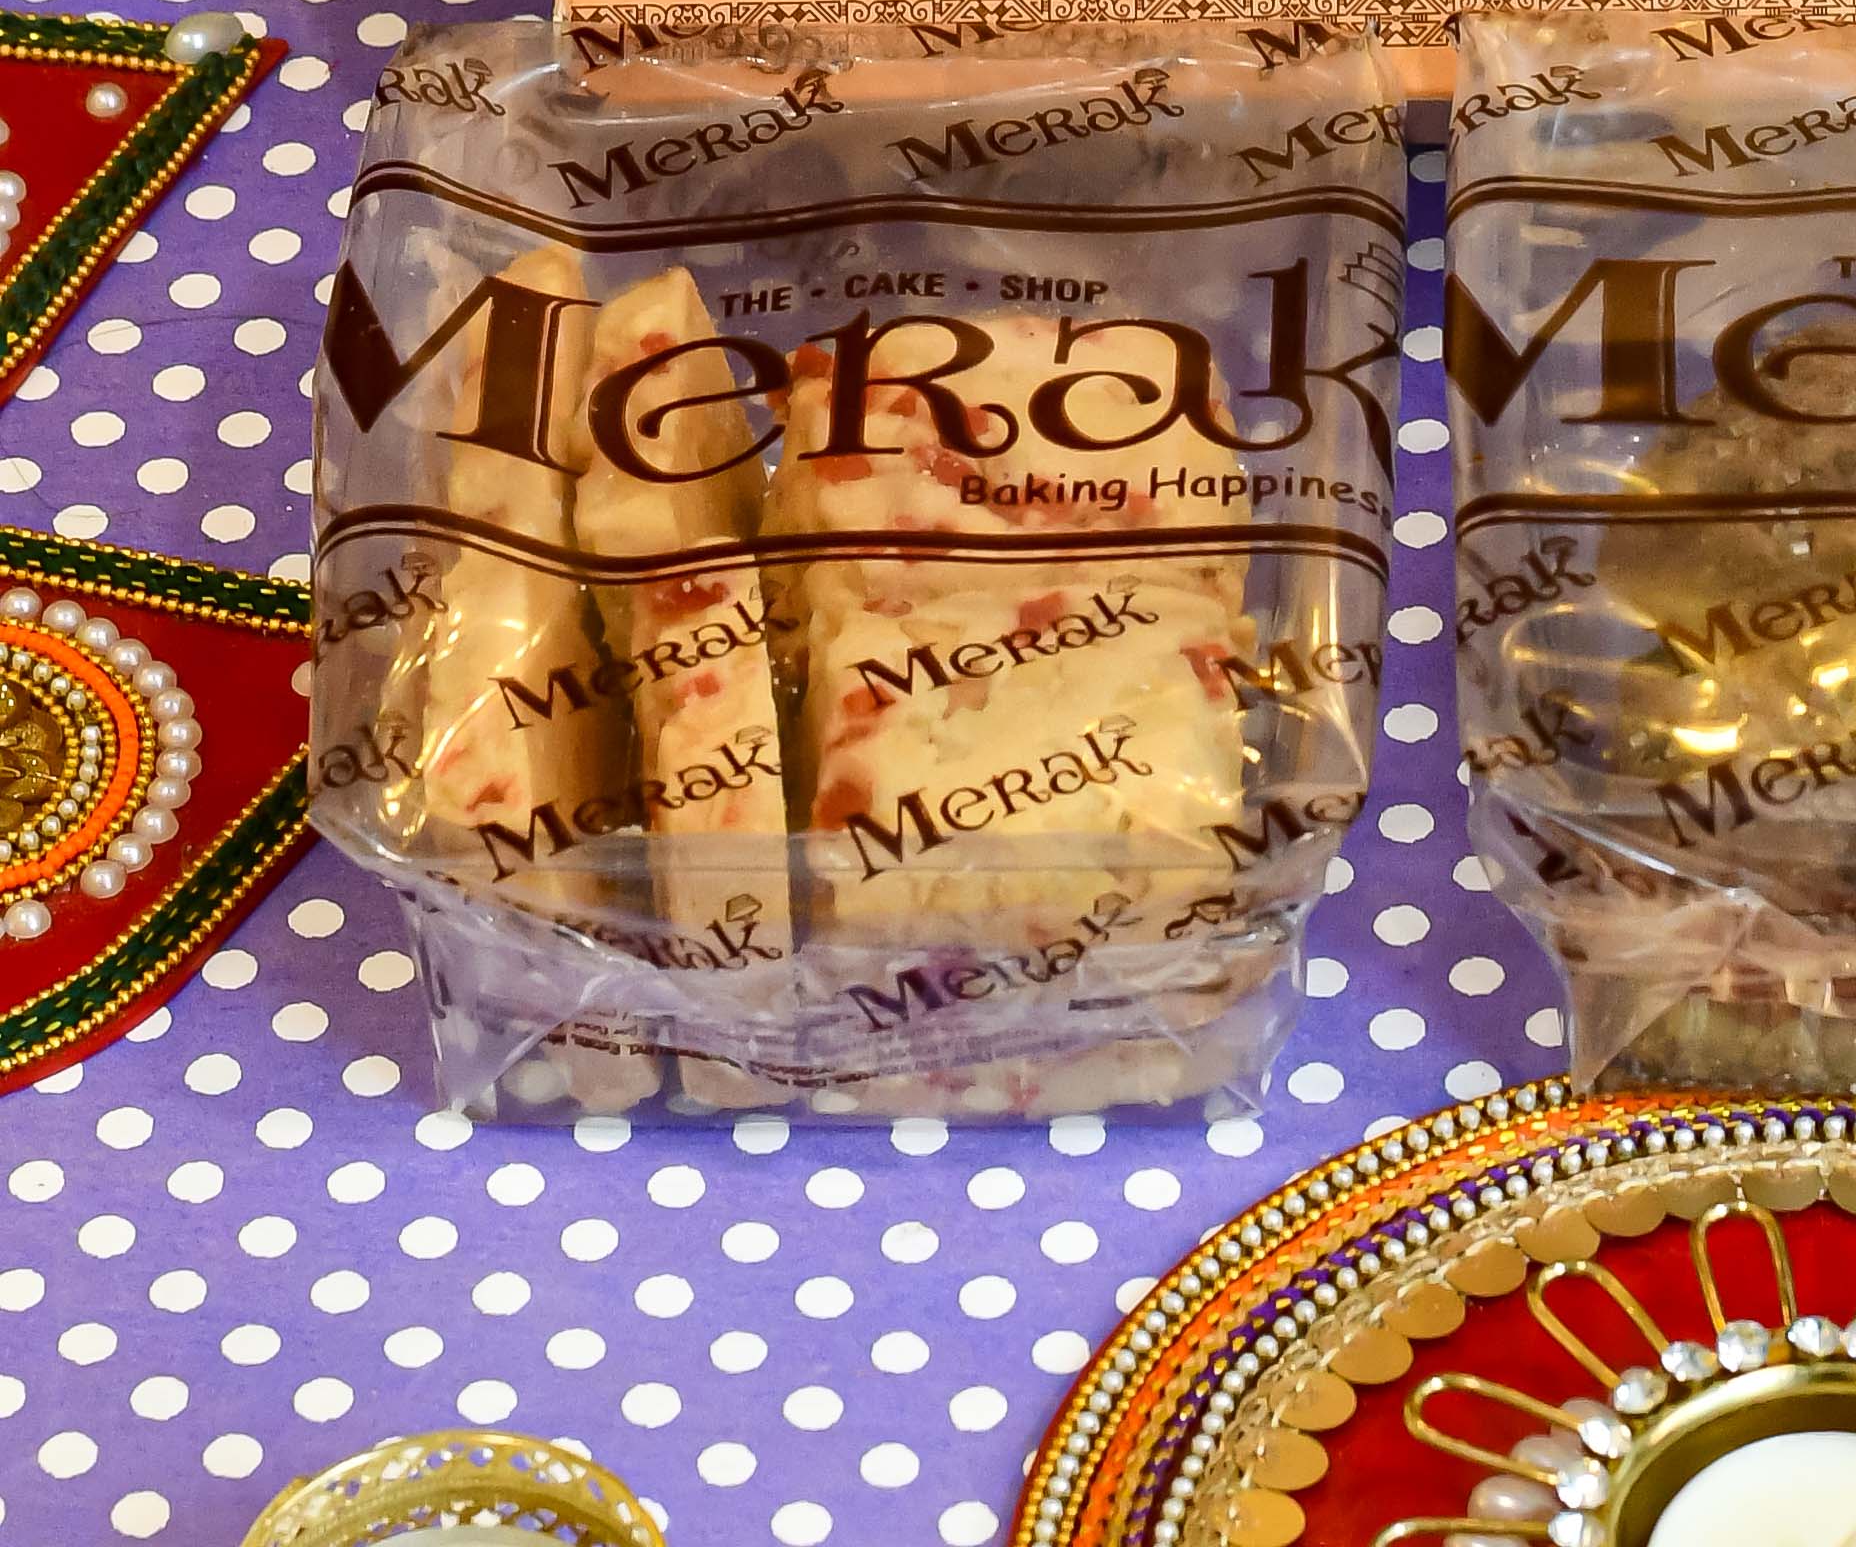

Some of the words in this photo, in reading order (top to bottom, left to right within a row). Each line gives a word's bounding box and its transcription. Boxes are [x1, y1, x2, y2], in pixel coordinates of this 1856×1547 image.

[721, 285, 793, 319] THE
[845, 273, 946, 299] CAKE
[999, 274, 1109, 304] SHOP
[959, 472, 1128, 510] Baking
